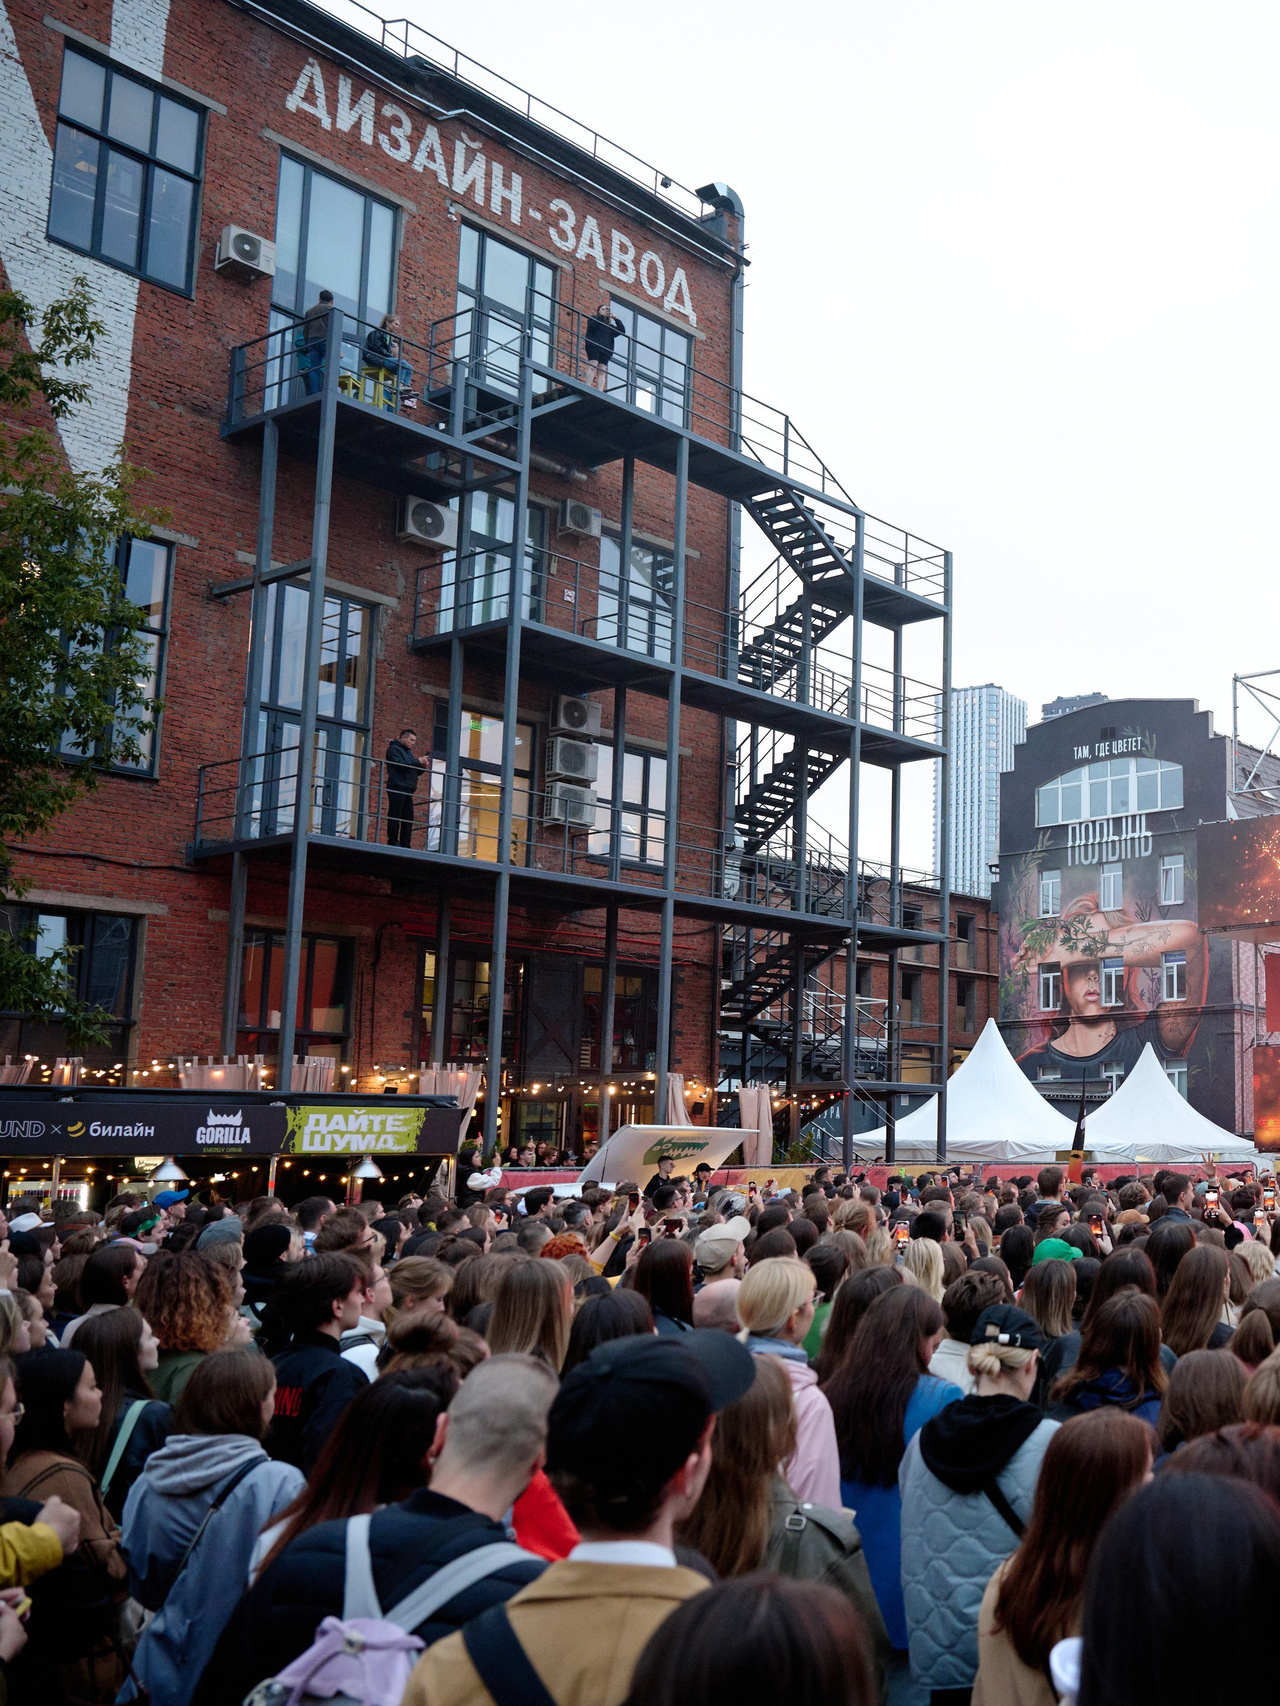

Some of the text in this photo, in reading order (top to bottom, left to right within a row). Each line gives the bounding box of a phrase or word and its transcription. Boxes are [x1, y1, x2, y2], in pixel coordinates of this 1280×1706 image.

[286, 57, 698, 327] ДИЗАЙН-ЗАВОД
[1073, 736, 1142, 760] ТАМ, ГДЕ ЦВЕТЕТ
[1067, 813, 1153, 867] ПОЛЫНЬ
[89, 1121, 155, 1137] билайн
[303, 1109, 412, 1134] ДАЙТЕ
[195, 1126, 251, 1144] GORILLA
[302, 1133, 408, 1152] ШУМА
